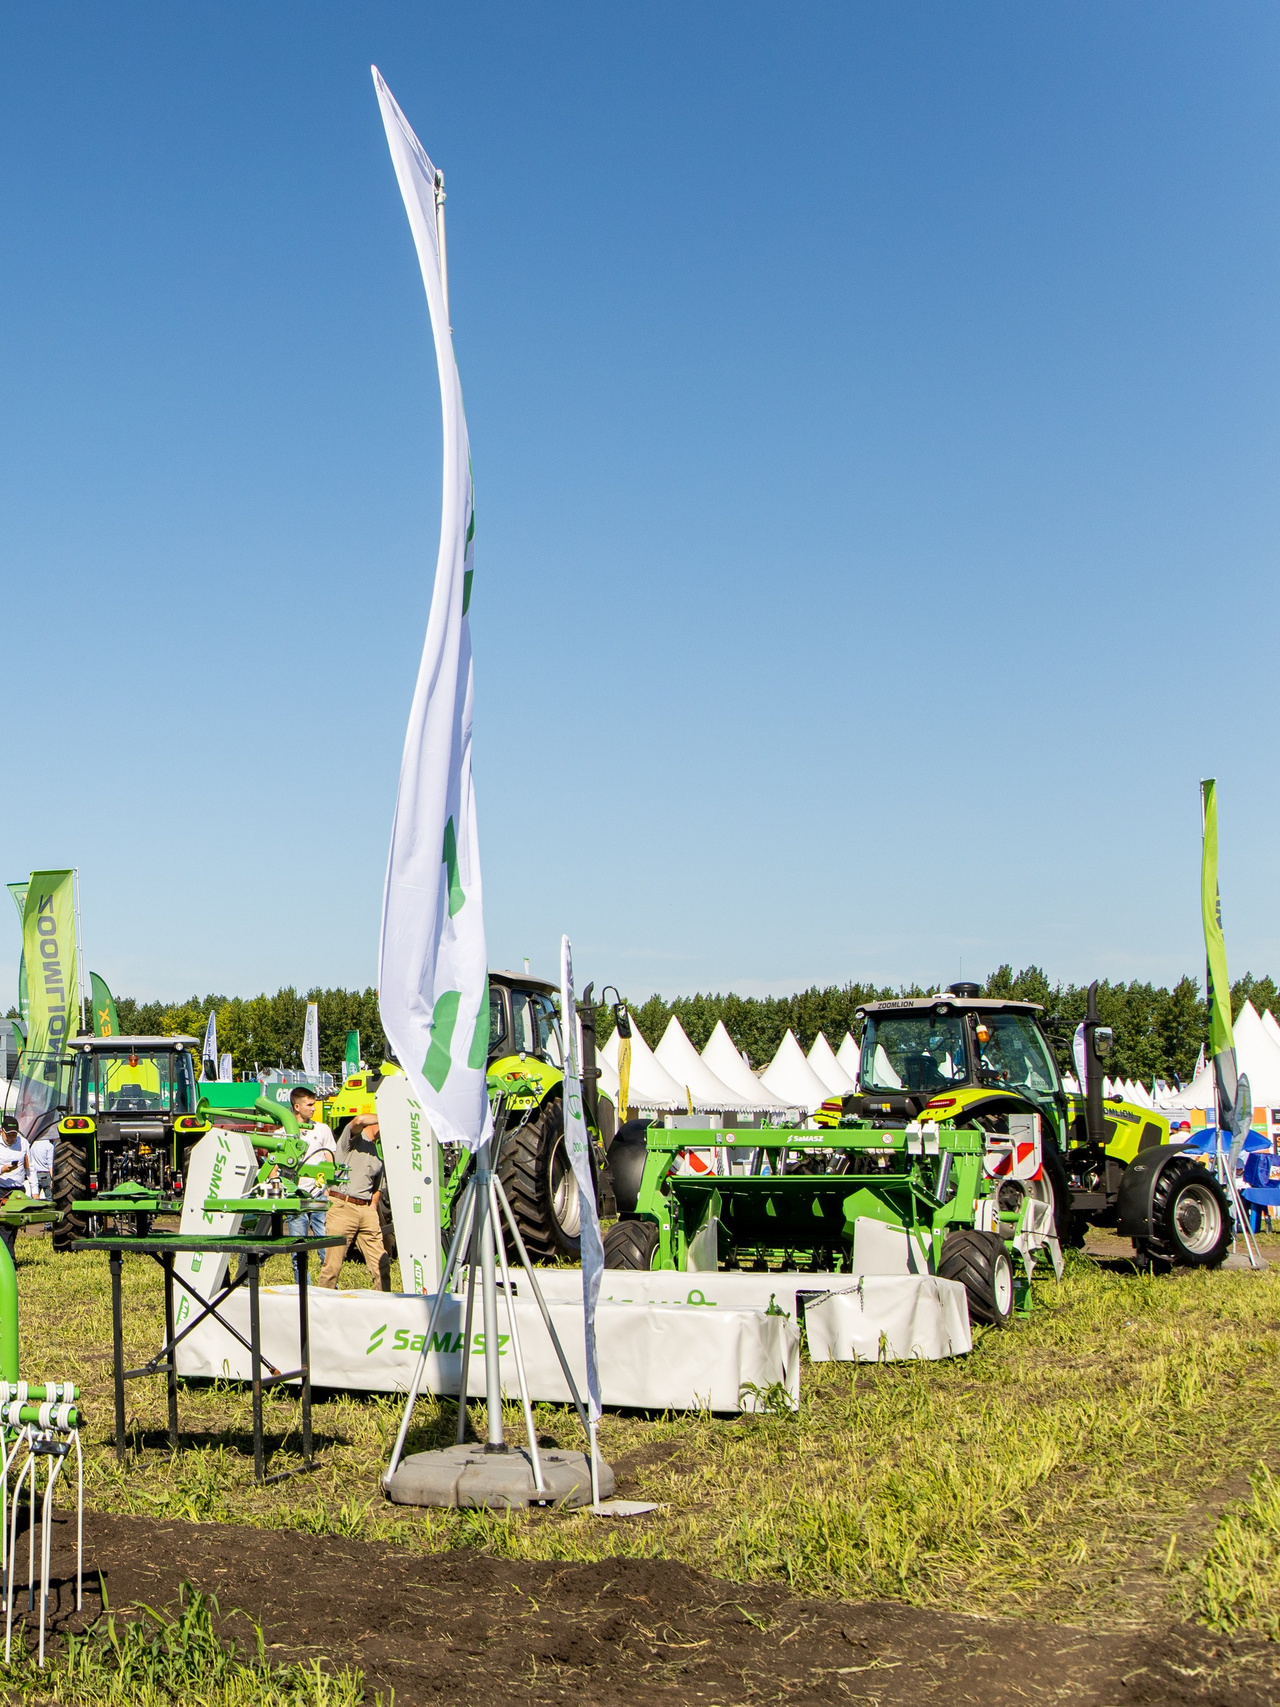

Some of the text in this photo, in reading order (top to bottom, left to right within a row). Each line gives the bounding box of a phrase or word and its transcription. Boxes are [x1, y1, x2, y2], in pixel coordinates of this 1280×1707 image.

[877, 1001, 915, 1010] ZOOMLION
[1102, 1107, 1134, 1119] OMLION
[410, 1112, 423, 1172] SaMASZ
[202, 1152, 227, 1225] SaMAZ
[391, 1328, 511, 1356] SaMASZ
